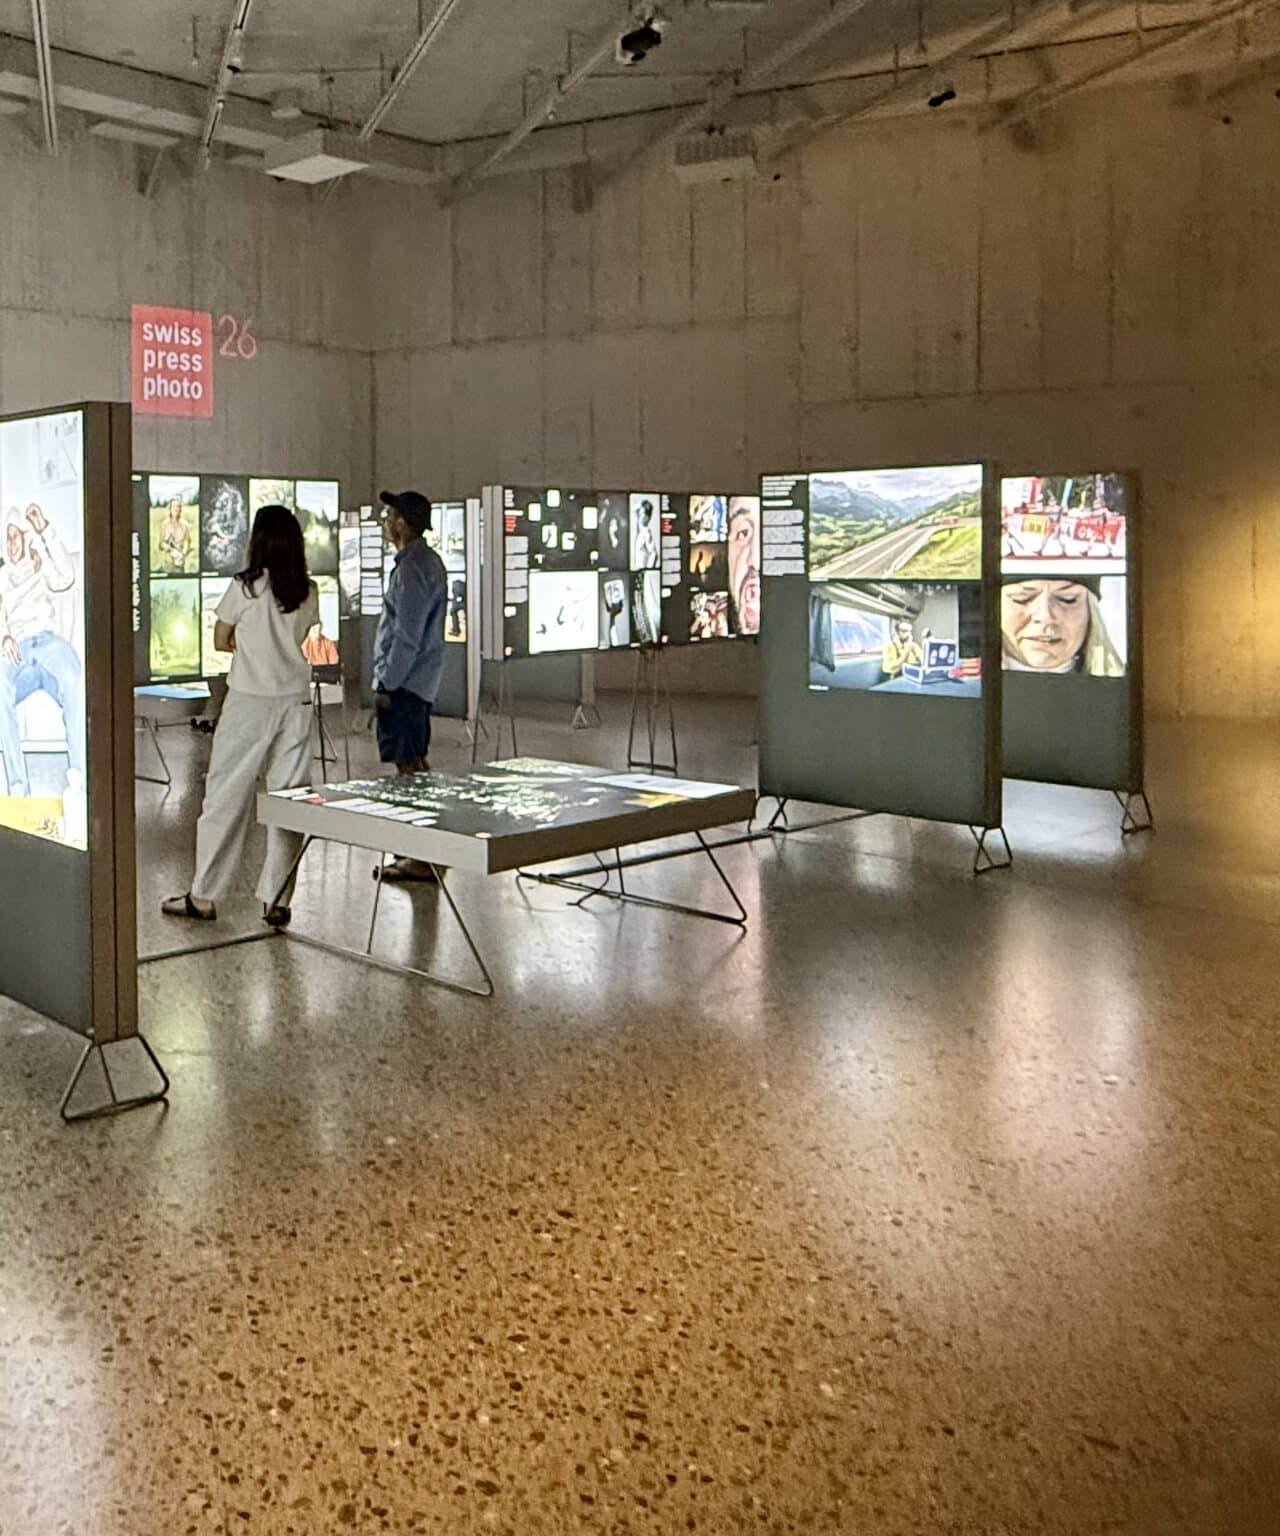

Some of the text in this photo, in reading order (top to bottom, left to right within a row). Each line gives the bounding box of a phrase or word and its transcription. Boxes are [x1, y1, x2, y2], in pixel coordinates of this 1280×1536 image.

[143, 322, 202, 346] swiss
[219, 314, 257, 359] 26
[144, 349, 202, 372] press
[144, 374, 203, 400] photo
